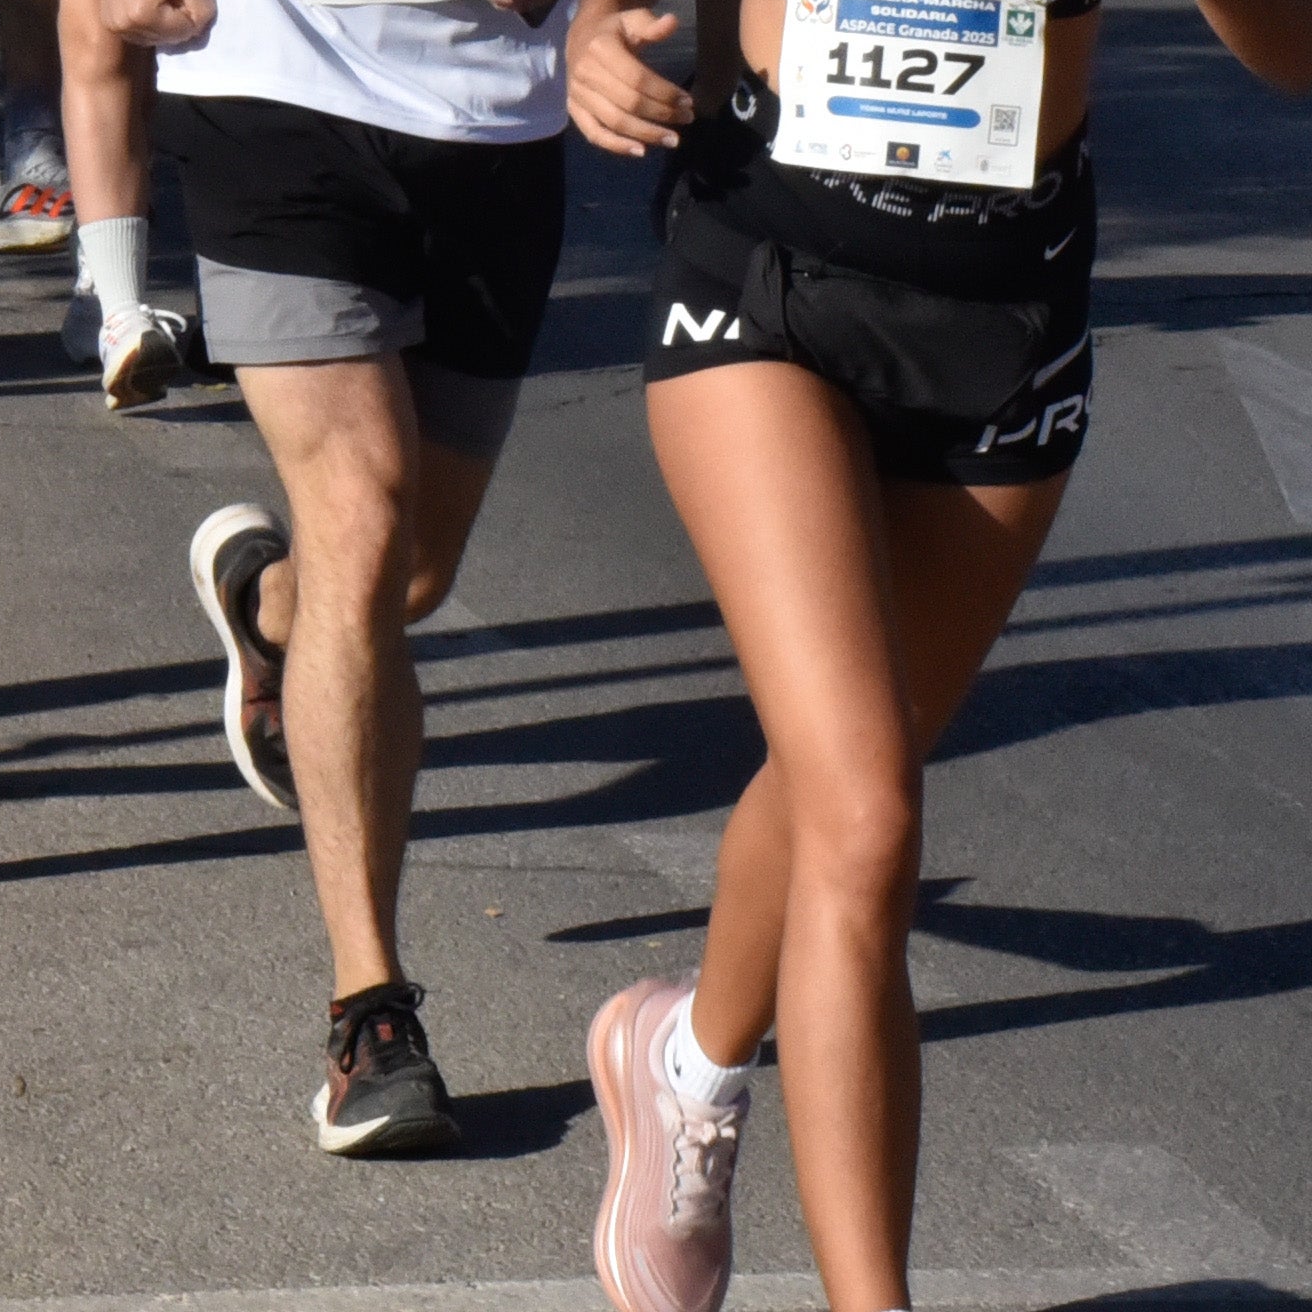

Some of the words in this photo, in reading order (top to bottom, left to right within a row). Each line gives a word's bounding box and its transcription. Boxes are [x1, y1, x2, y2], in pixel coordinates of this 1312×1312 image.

[870, 4, 959, 24] SOLIDARIA
[839, 18, 896, 36] ASPACE
[898, 23, 959, 43] Granada
[960, 29, 995, 46] 2025
[826, 41, 987, 96] 1127
